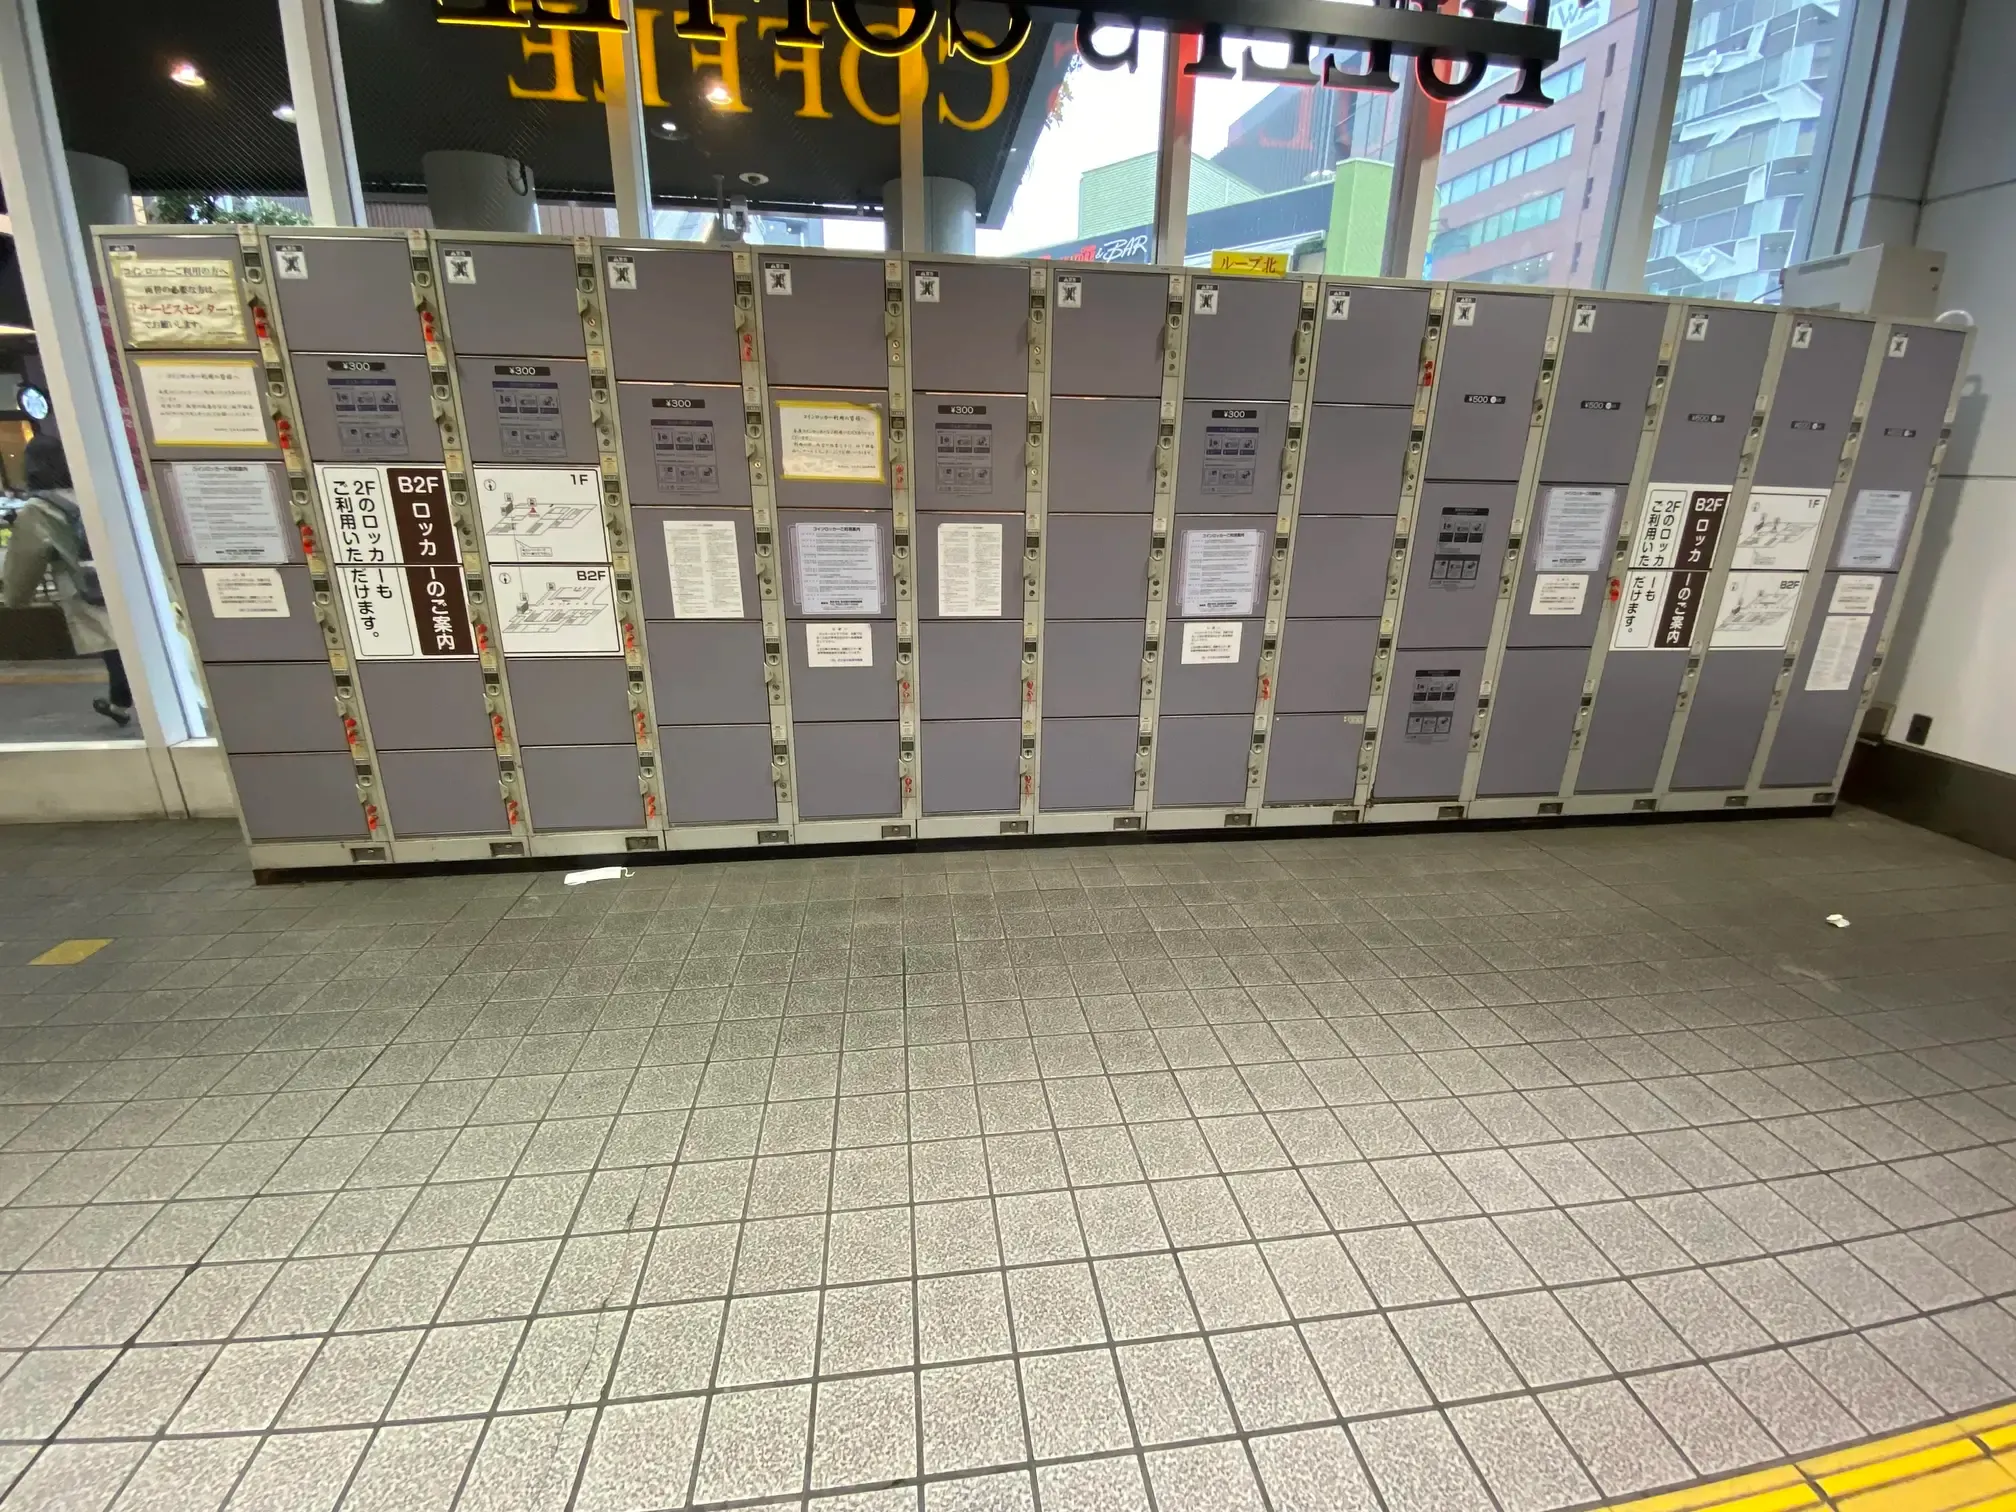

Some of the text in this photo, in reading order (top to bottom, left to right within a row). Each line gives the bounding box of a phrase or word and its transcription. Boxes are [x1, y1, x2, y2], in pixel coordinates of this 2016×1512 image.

[1103, 235, 1148, 263] BAR
[1220, 256, 1278, 274] ループ北
[343, 361, 370, 372] ¥300
[509, 366, 536, 376] ¥300
[665, 398, 692, 408] ¥300
[950, 405, 974, 415] ¥300
[1223, 410, 1246, 418] ¥300
[398, 475, 440, 494] B2F
[570, 473, 589, 486] 1F
[1694, 497, 1725, 512] B2F
[1807, 499, 1821, 509] 1F
[332, 480, 380, 639] ご利用いただけます。
[1624, 500, 1663, 633] ご利用いただけます。
[411, 501, 455, 651] ロッカーのご案内
[576, 570, 606, 582] B2F
[1666, 519, 1710, 644] ロッカーのご案内
[1779, 580, 1801, 590] B2F
